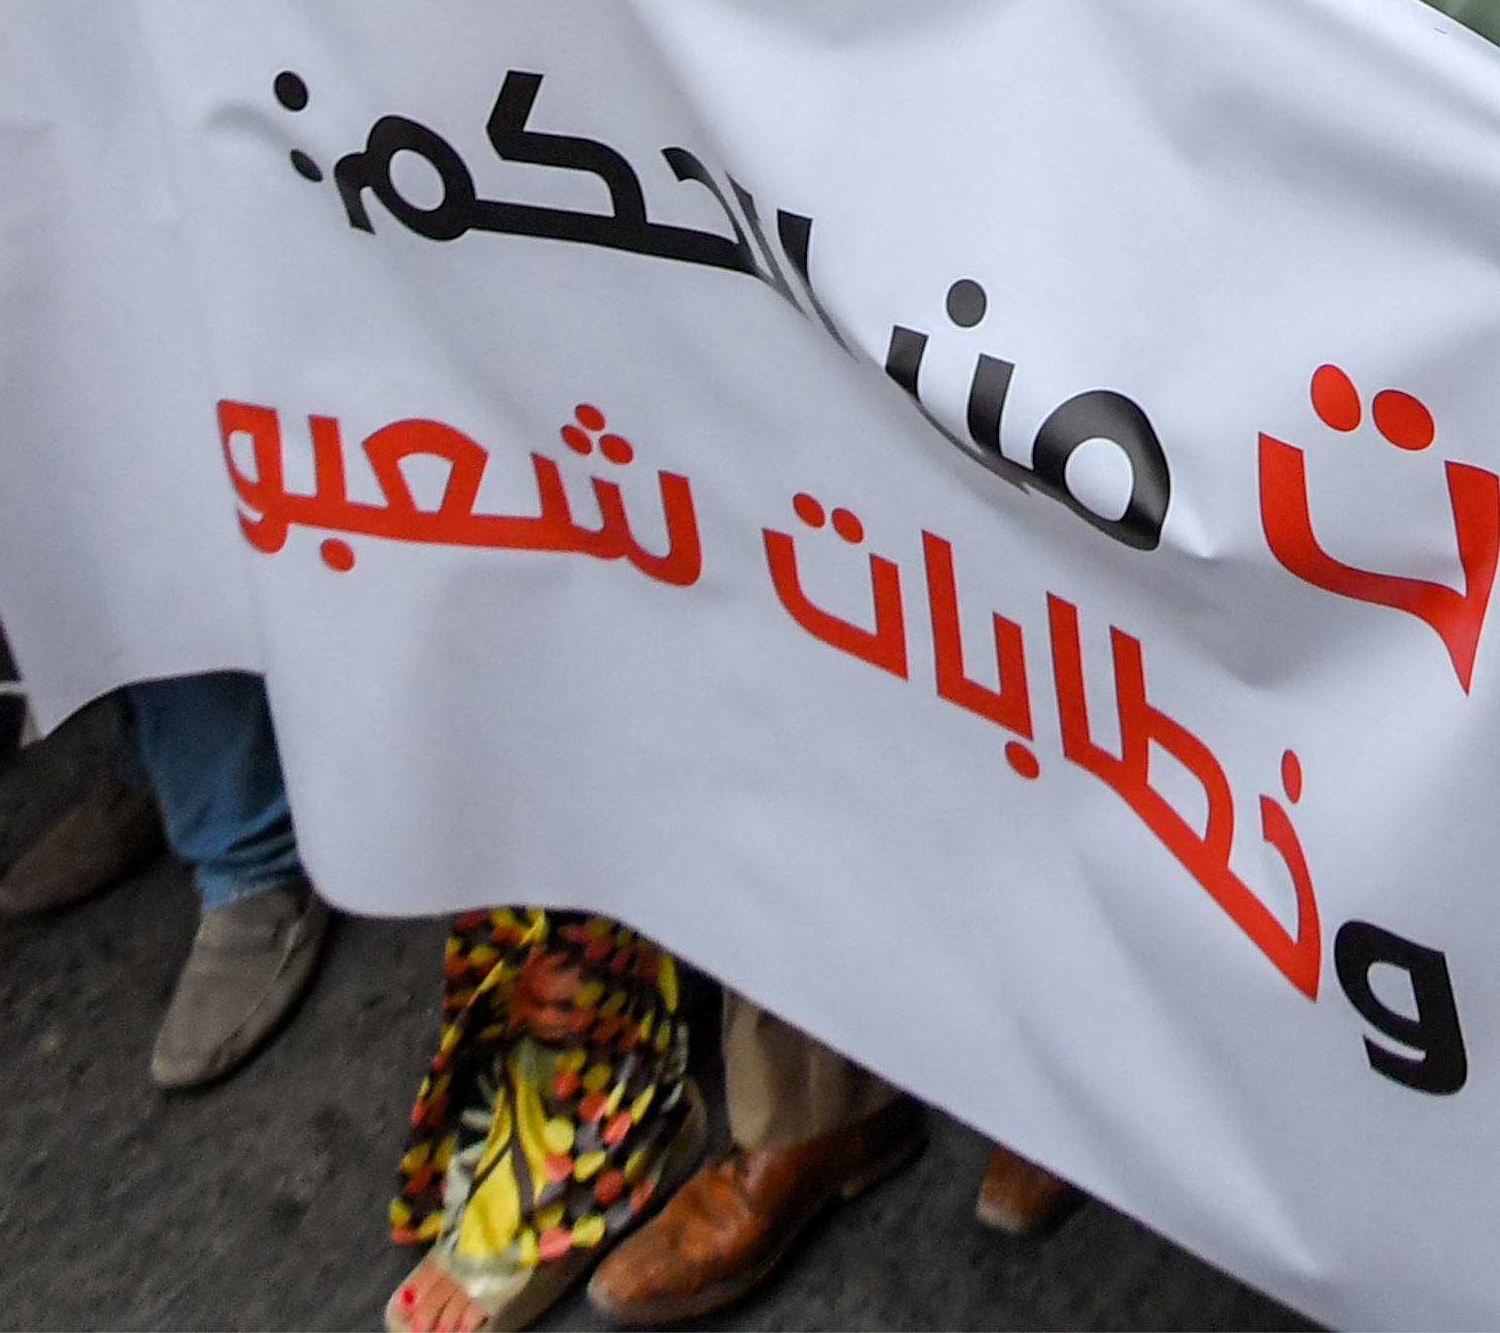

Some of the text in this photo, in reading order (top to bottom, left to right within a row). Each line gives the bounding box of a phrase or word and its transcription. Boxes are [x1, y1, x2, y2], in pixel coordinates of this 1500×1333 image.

[884, 277, 1171, 552] من
[761, 492, 1320, 1002] خطابات
[1334, 917, 1468, 1095] و
